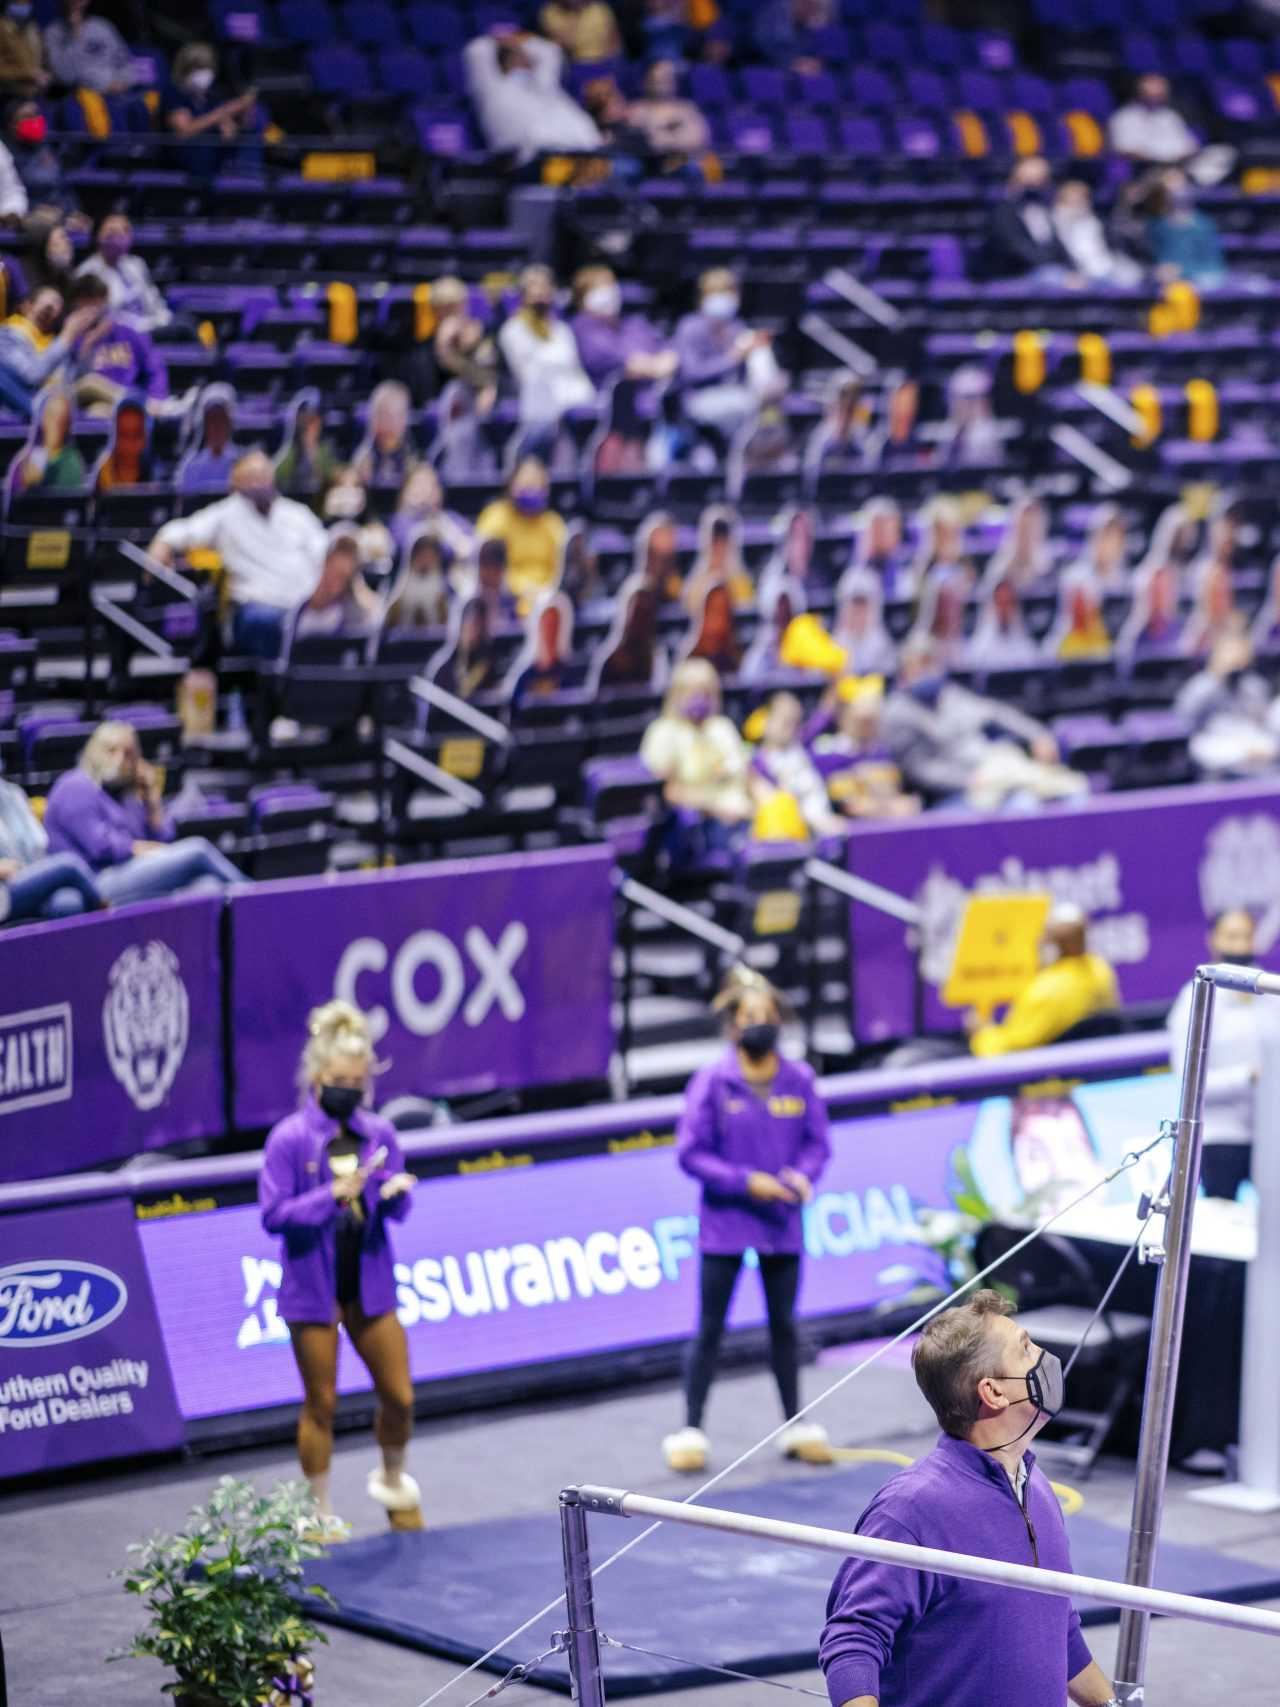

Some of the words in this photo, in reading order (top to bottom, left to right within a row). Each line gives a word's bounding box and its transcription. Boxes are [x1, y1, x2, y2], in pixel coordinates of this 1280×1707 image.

[334, 920, 528, 1037] COX
[0, 1024, 64, 1095] ALTH
[0, 1271, 94, 1337] Ford
[48, 1391, 134, 1424] Dealers
[69, 1358, 149, 1396] Quality
